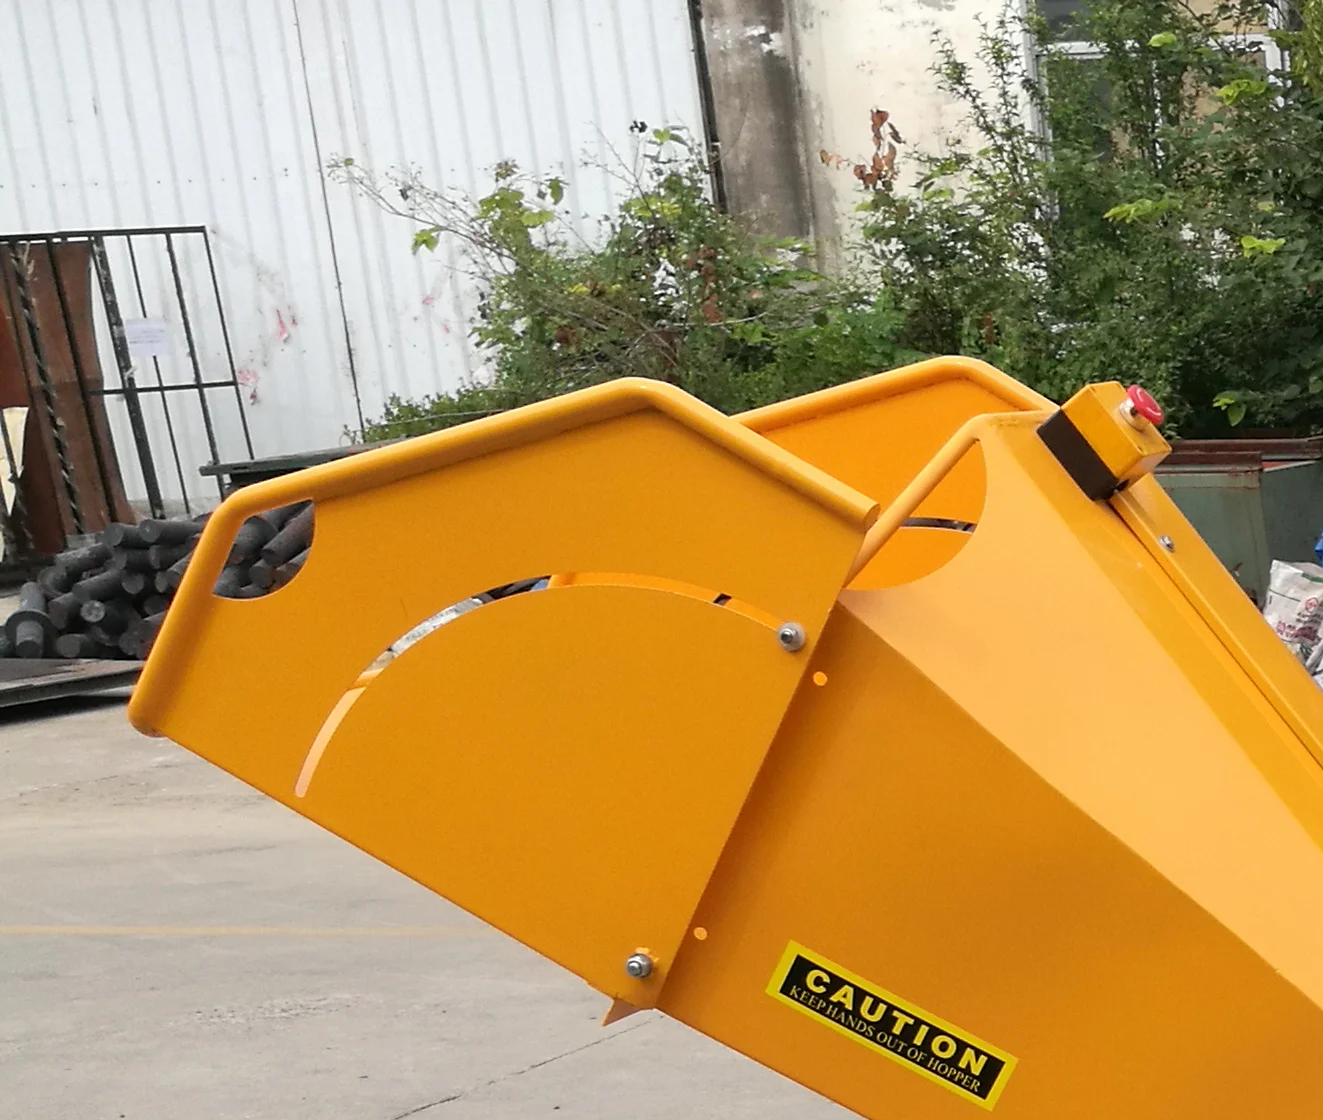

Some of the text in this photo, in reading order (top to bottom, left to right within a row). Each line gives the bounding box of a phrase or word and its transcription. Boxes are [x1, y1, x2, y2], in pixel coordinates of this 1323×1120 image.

[789, 985, 981, 1093] KEEP HANDS OUT OF HOPPER
[805, 969, 988, 1076] CAUTION
